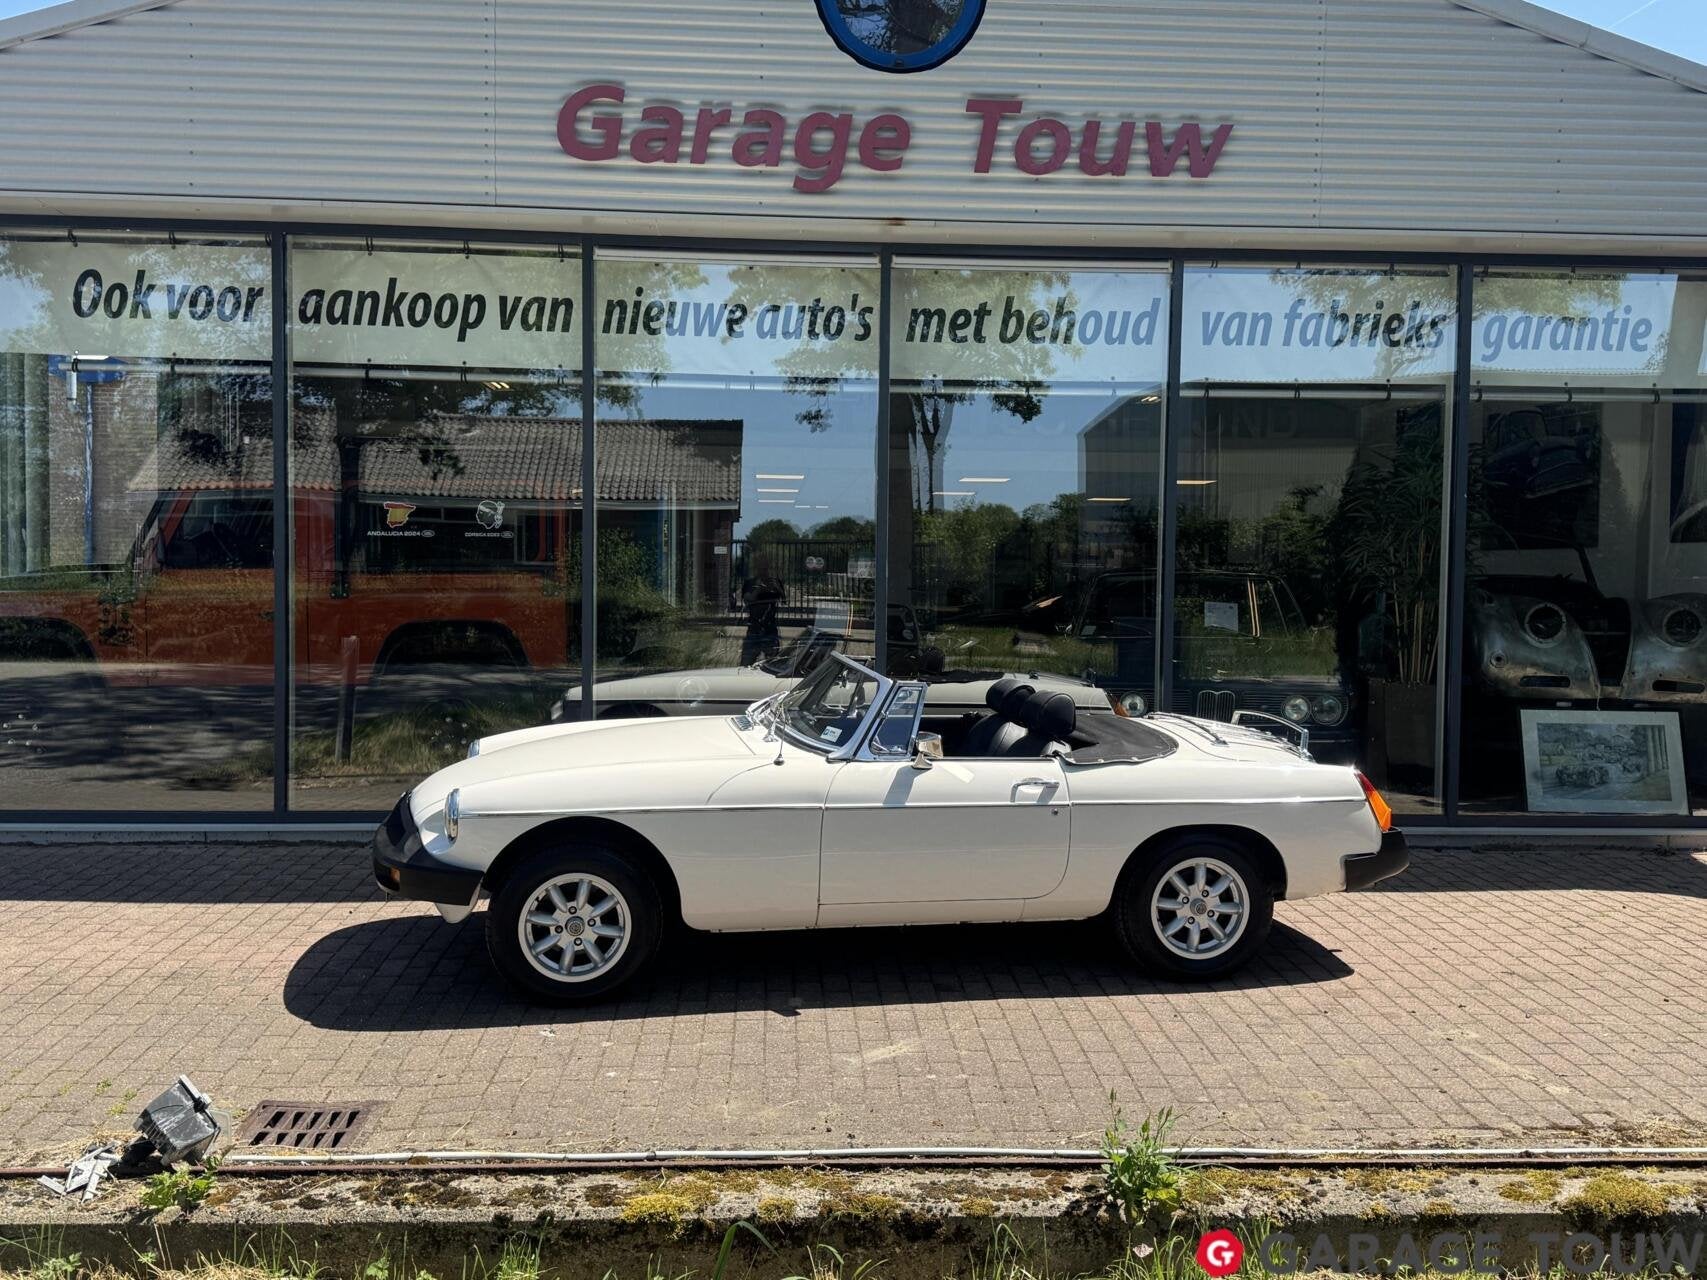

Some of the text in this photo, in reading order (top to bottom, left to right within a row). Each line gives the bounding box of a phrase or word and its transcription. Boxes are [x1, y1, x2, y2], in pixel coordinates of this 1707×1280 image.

[557, 85, 1235, 193] Garage Touw
[73, 268, 1653, 363] Ook voor aankoop van nieuwe auto's met behoud van fabrieks garantie
